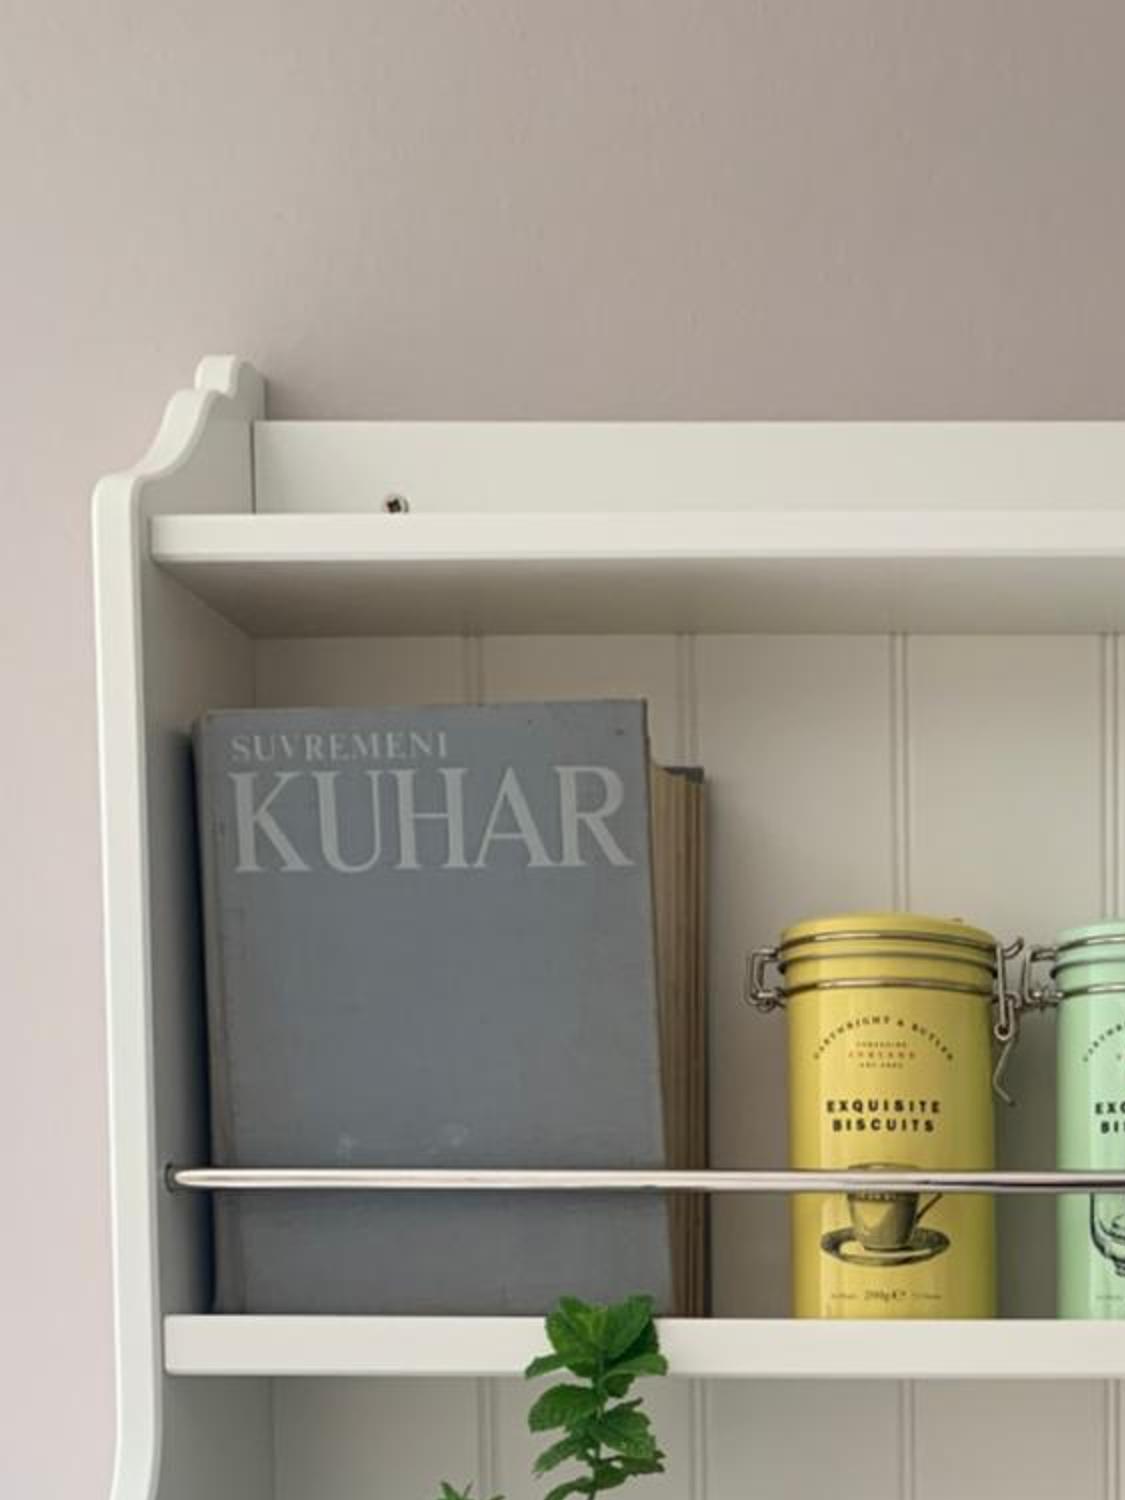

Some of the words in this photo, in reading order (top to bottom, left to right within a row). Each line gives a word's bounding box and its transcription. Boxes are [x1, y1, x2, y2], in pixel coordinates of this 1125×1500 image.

[230, 732, 449, 761] SUVREMENI
[228, 765, 636, 874] KUHAR
[826, 1100, 941, 1114] EXQUISITE
[832, 1119, 936, 1133] BISCUITS
